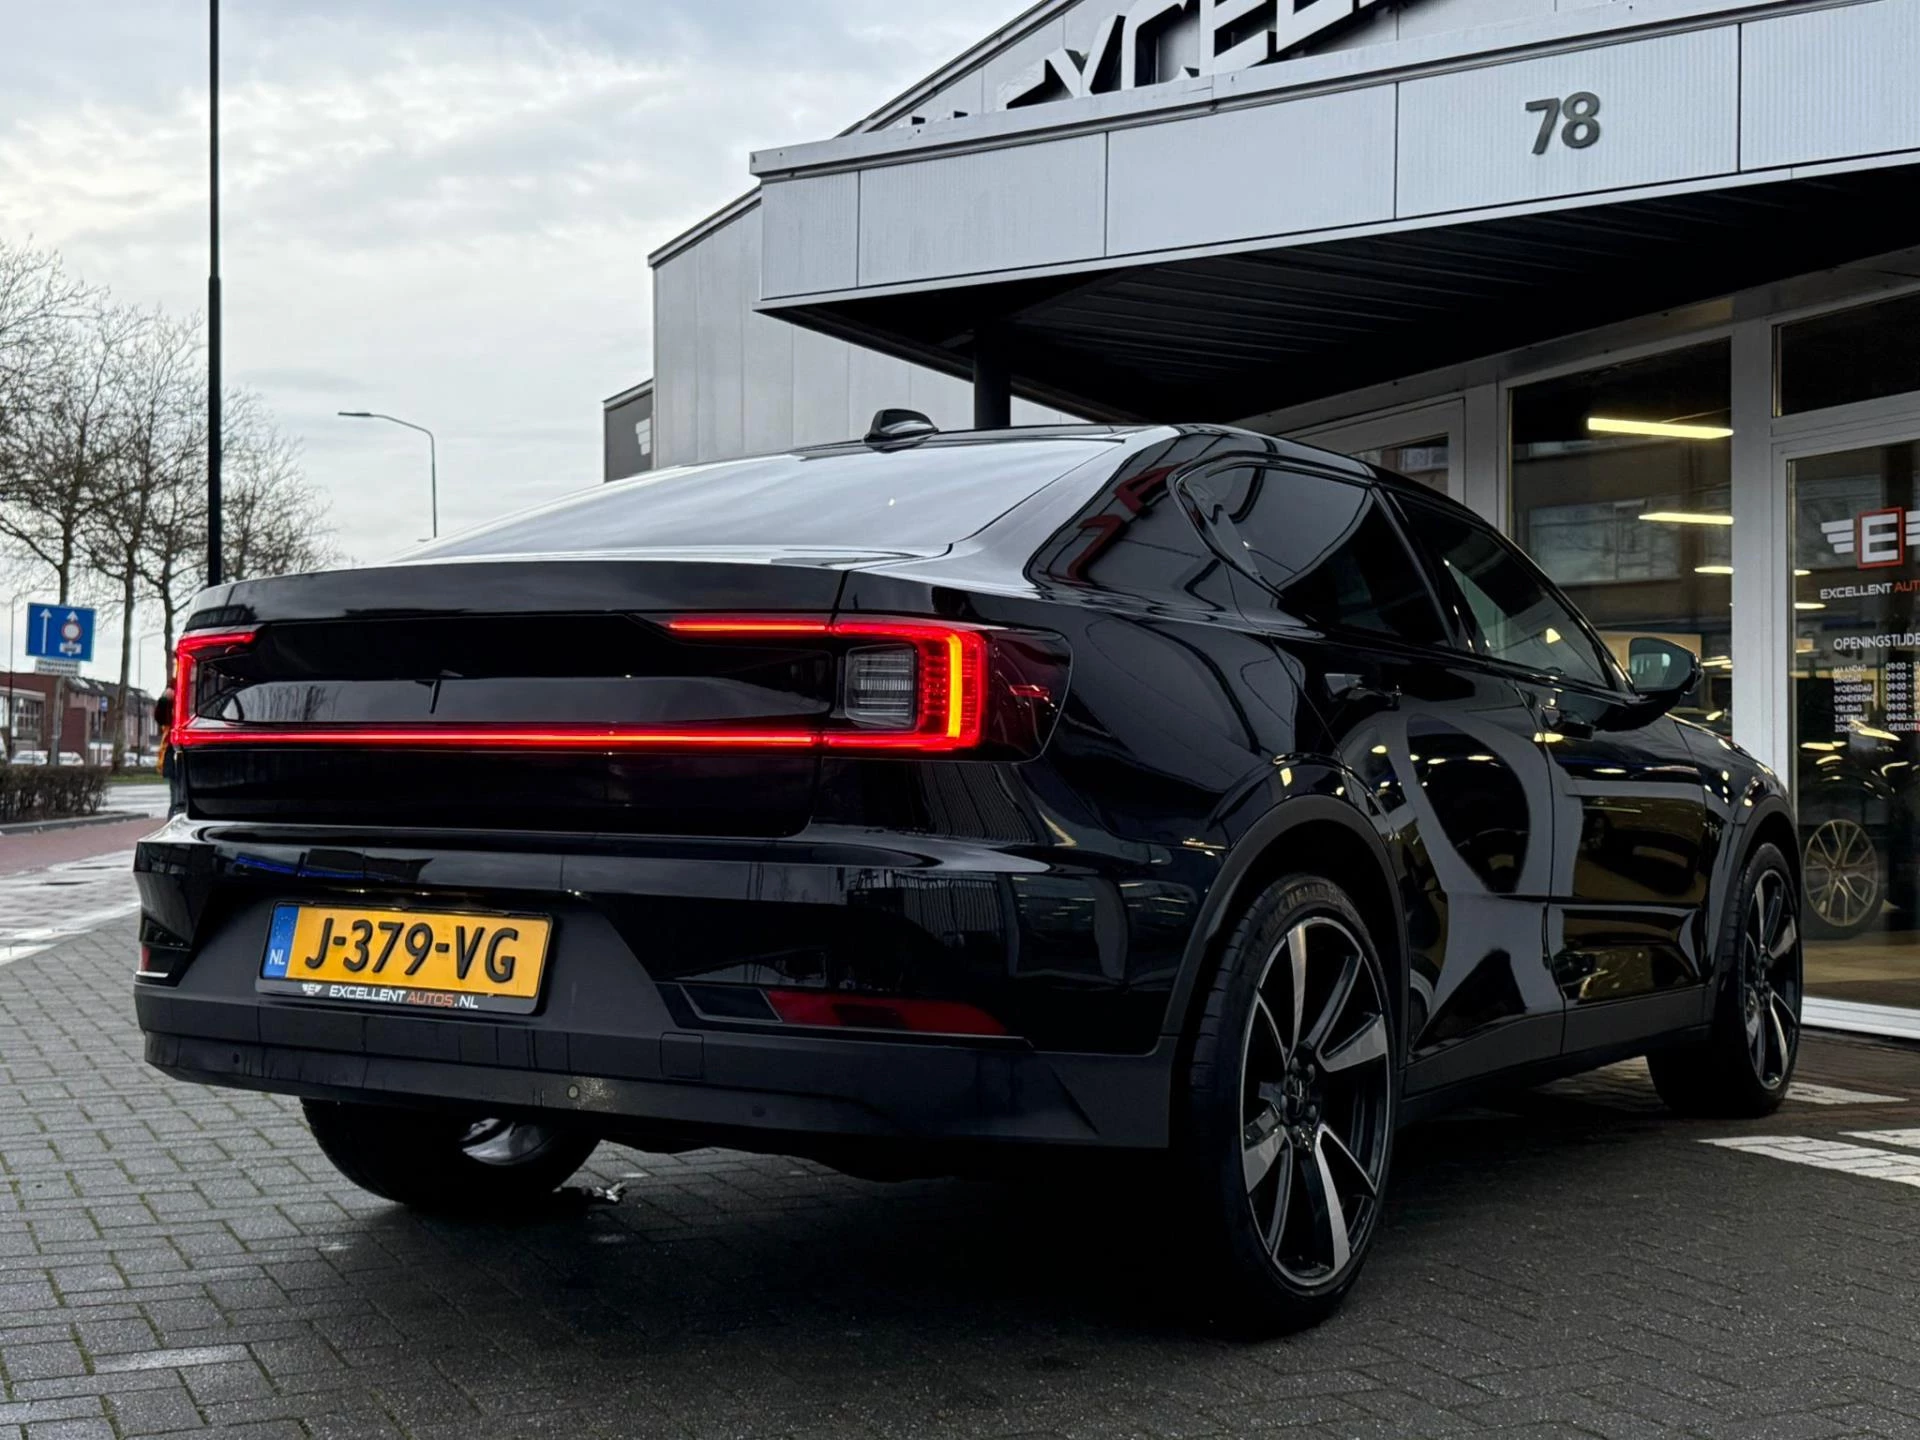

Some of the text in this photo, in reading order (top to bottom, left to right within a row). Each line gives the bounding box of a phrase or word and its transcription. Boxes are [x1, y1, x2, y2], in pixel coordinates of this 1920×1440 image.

[1525, 91, 1600, 156] 78
[1820, 582, 1893, 600] EXCELLENT
[1834, 683, 1873, 693] WOENSDAG
[1834, 693, 1875, 704] DONDERDAG
[1834, 703, 1863, 713] VRIJDAG
[269, 949, 286, 966] NL
[305, 917, 519, 983] J-379-VG
[329, 984, 406, 1003] EXCELLENT
